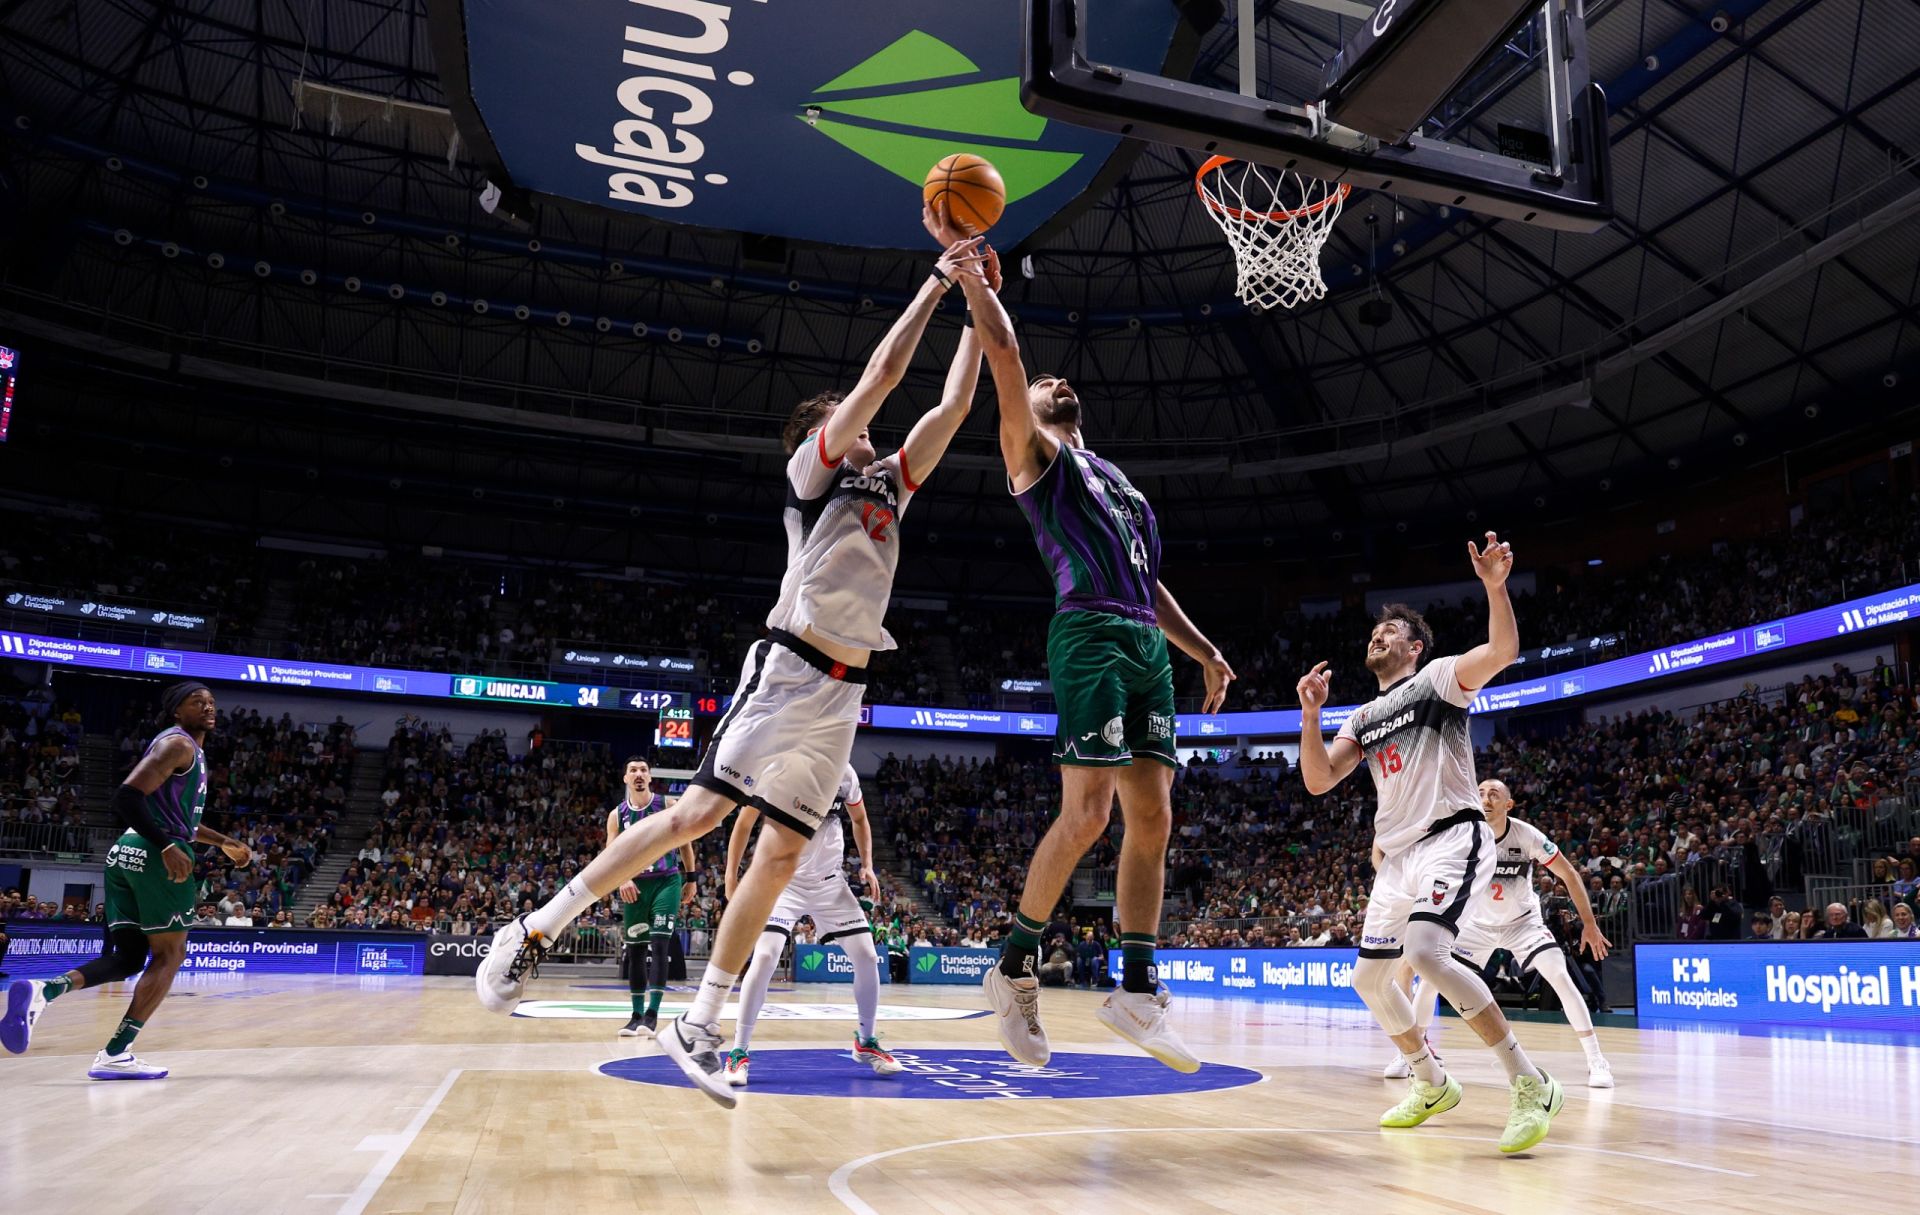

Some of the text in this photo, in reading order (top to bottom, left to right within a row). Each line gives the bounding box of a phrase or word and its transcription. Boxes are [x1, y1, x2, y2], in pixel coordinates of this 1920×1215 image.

[575, 0, 755, 208] nicaja
[861, 501, 893, 543] 12
[24, 601, 53, 611] Unicaja
[25, 595, 64, 606] Fundación
[1865, 597, 1909, 616] Diputación
[97, 610, 125, 620] Unicaja
[98, 604, 136, 615] Fundación
[168, 614, 205, 624] Fundación
[168, 619, 194, 628] Unicaja
[1866, 610, 1909, 626] de Málaga
[29, 638, 120, 656] Diputación Provincial
[1670, 635, 1735, 659] Diputación Provincial
[28, 648, 74, 661] de Málaga
[576, 654, 600, 663] Unicaja
[1671, 654, 1703, 668] de Málaga
[624, 658, 648, 667] Unicaja
[671, 661, 694, 671] Unicaja
[271, 666, 352, 681] Diputación Provincial
[271, 675, 311, 686] de Málaga
[486, 682, 546, 700] UNICAJA
[577, 687, 599, 707] 34
[1489, 685, 1547, 702] Diputación Provincial
[697, 698, 717, 712] 16
[1499, 699, 1520, 709] Málaga
[667, 709, 691, 719] 4:12
[934, 711, 1001, 722] Diputación Provincial
[665, 721, 690, 739] 24
[945, 720, 968, 729] Málaga
[1376, 743, 1403, 779] 15
[720, 764, 741, 780] vive
[120, 845, 148, 859] COSTA
[128, 856, 146, 866] SOL
[1490, 882, 1504, 901] 2
[7, 938, 41, 955] PRODUCTOS
[41, 935, 78, 955] AUTÓCTONOS
[78, 939, 85, 954] DE
[85, 939, 92, 954] LA
[1364, 935, 1389, 945] asisa
[186, 940, 318, 955] iputación Provincial
[430, 939, 491, 958] ende
[182, 955, 246, 971] e Málaga
[941, 953, 996, 967] Fundación
[827, 962, 853, 973] Unic
[941, 964, 981, 977] Unicaja
[1172, 960, 1186, 981] HM
[1187, 959, 1215, 982] Gálvez
[1231, 975, 1256, 989] hospitales
[1262, 961, 1305, 990] Hospital
[1307, 962, 1328, 986] HM
[1766, 965, 1890, 1013] Hospital
[1651, 985, 1738, 1010] hm hospitales
